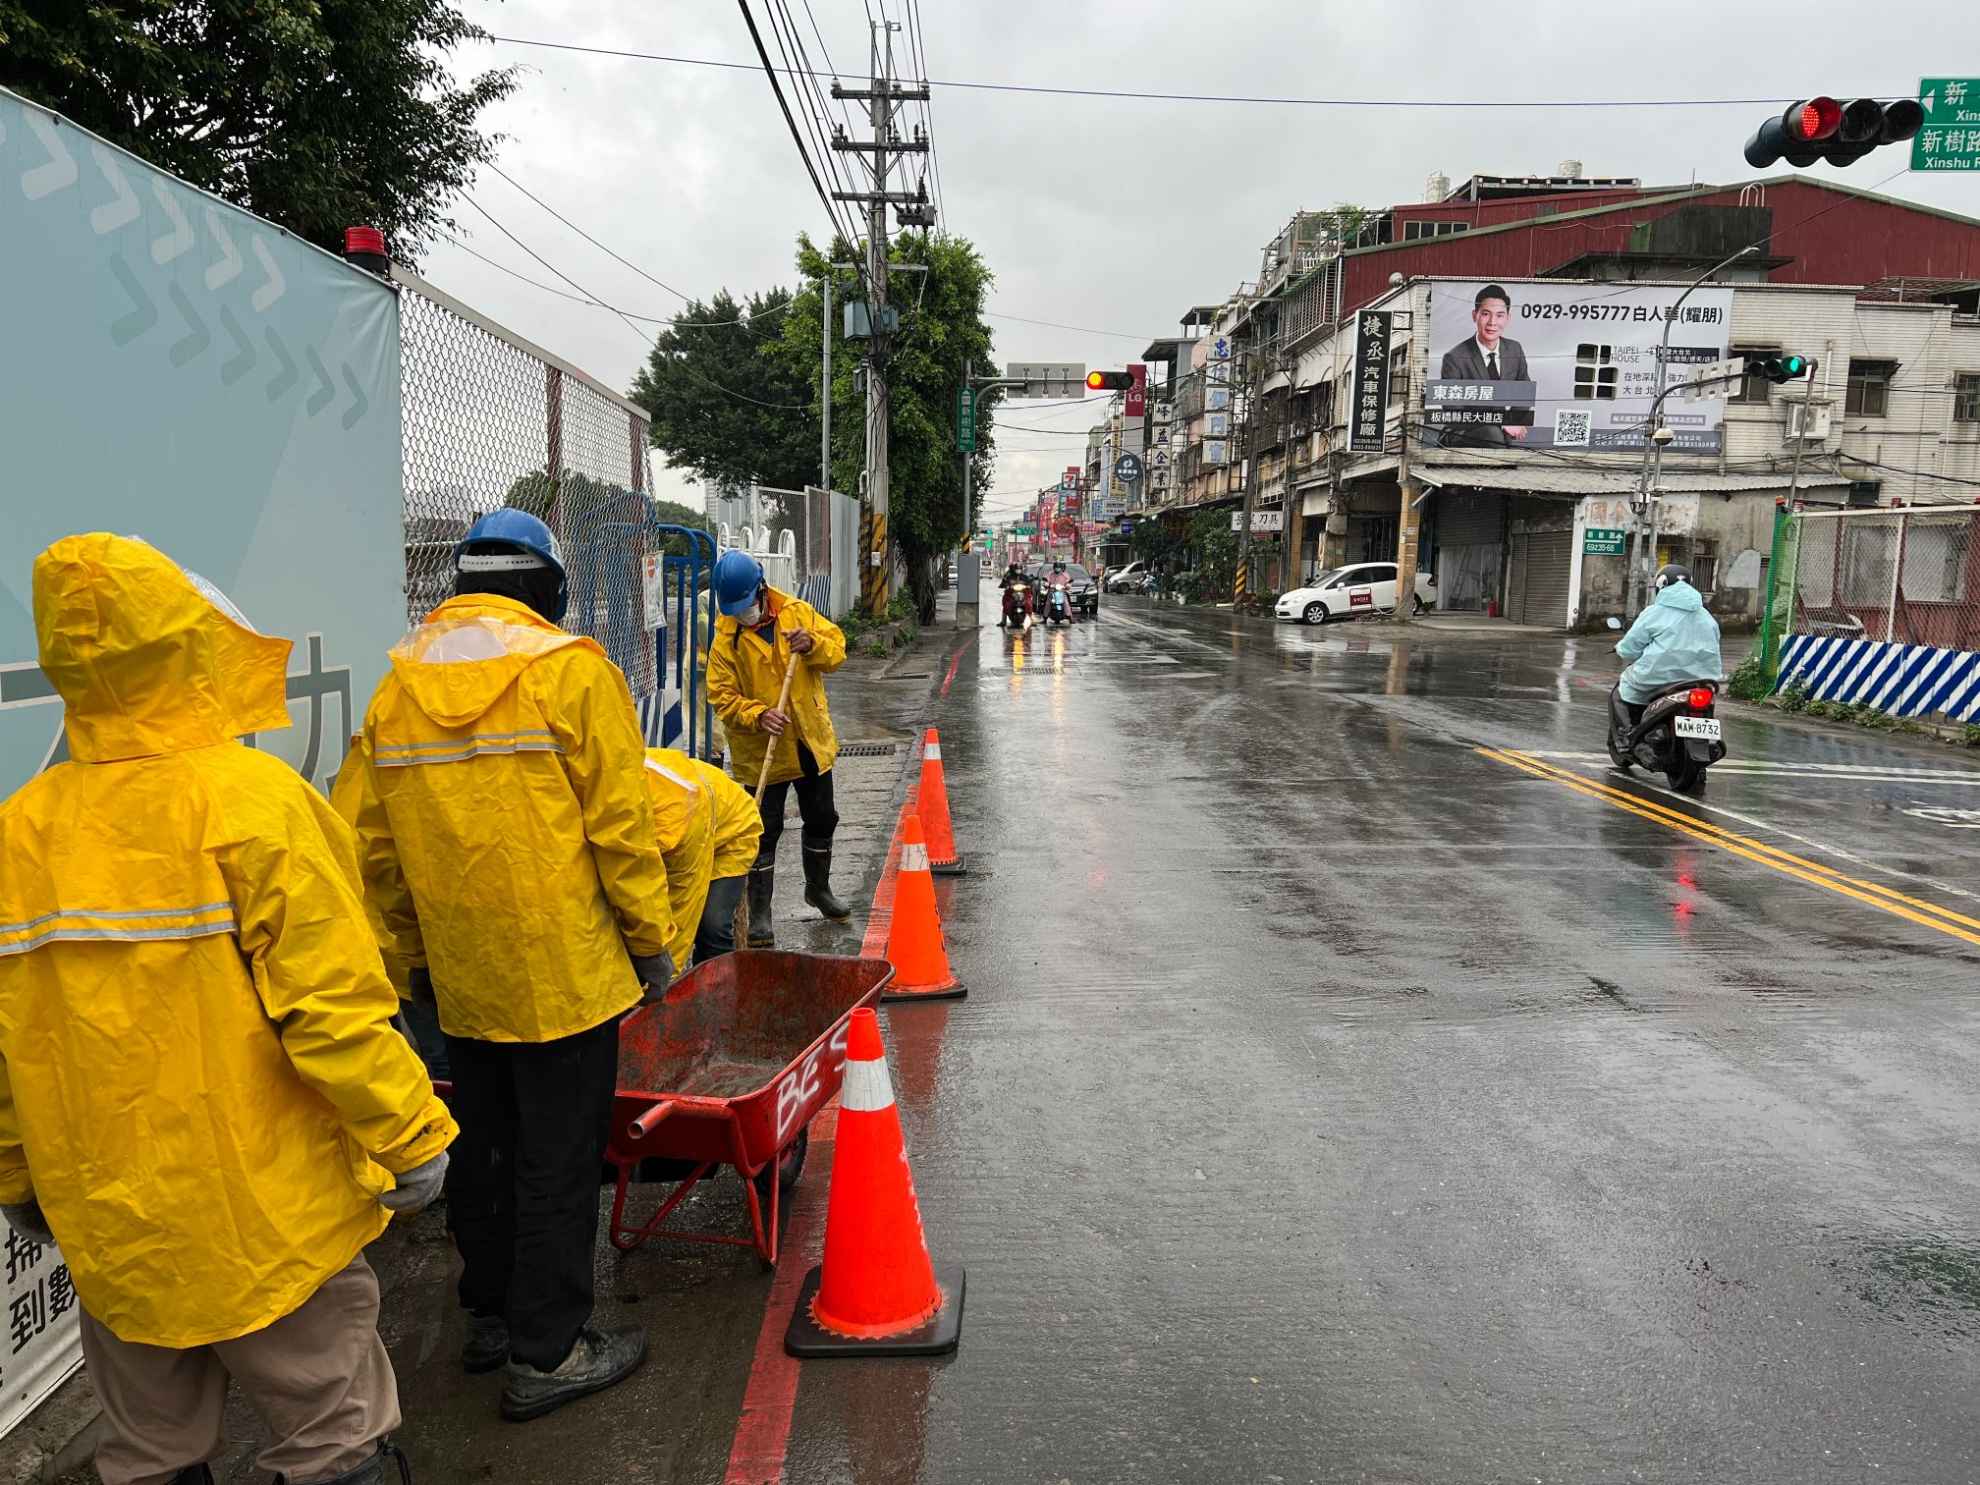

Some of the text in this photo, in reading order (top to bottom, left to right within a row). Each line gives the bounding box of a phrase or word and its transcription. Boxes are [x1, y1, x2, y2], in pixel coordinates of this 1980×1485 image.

[1956, 110, 1980, 121] Xin
[1924, 157, 1969, 168] Xinshu
[1521, 303, 1630, 321] 0929-995777
[1432, 385, 1494, 401] 東森房屋
